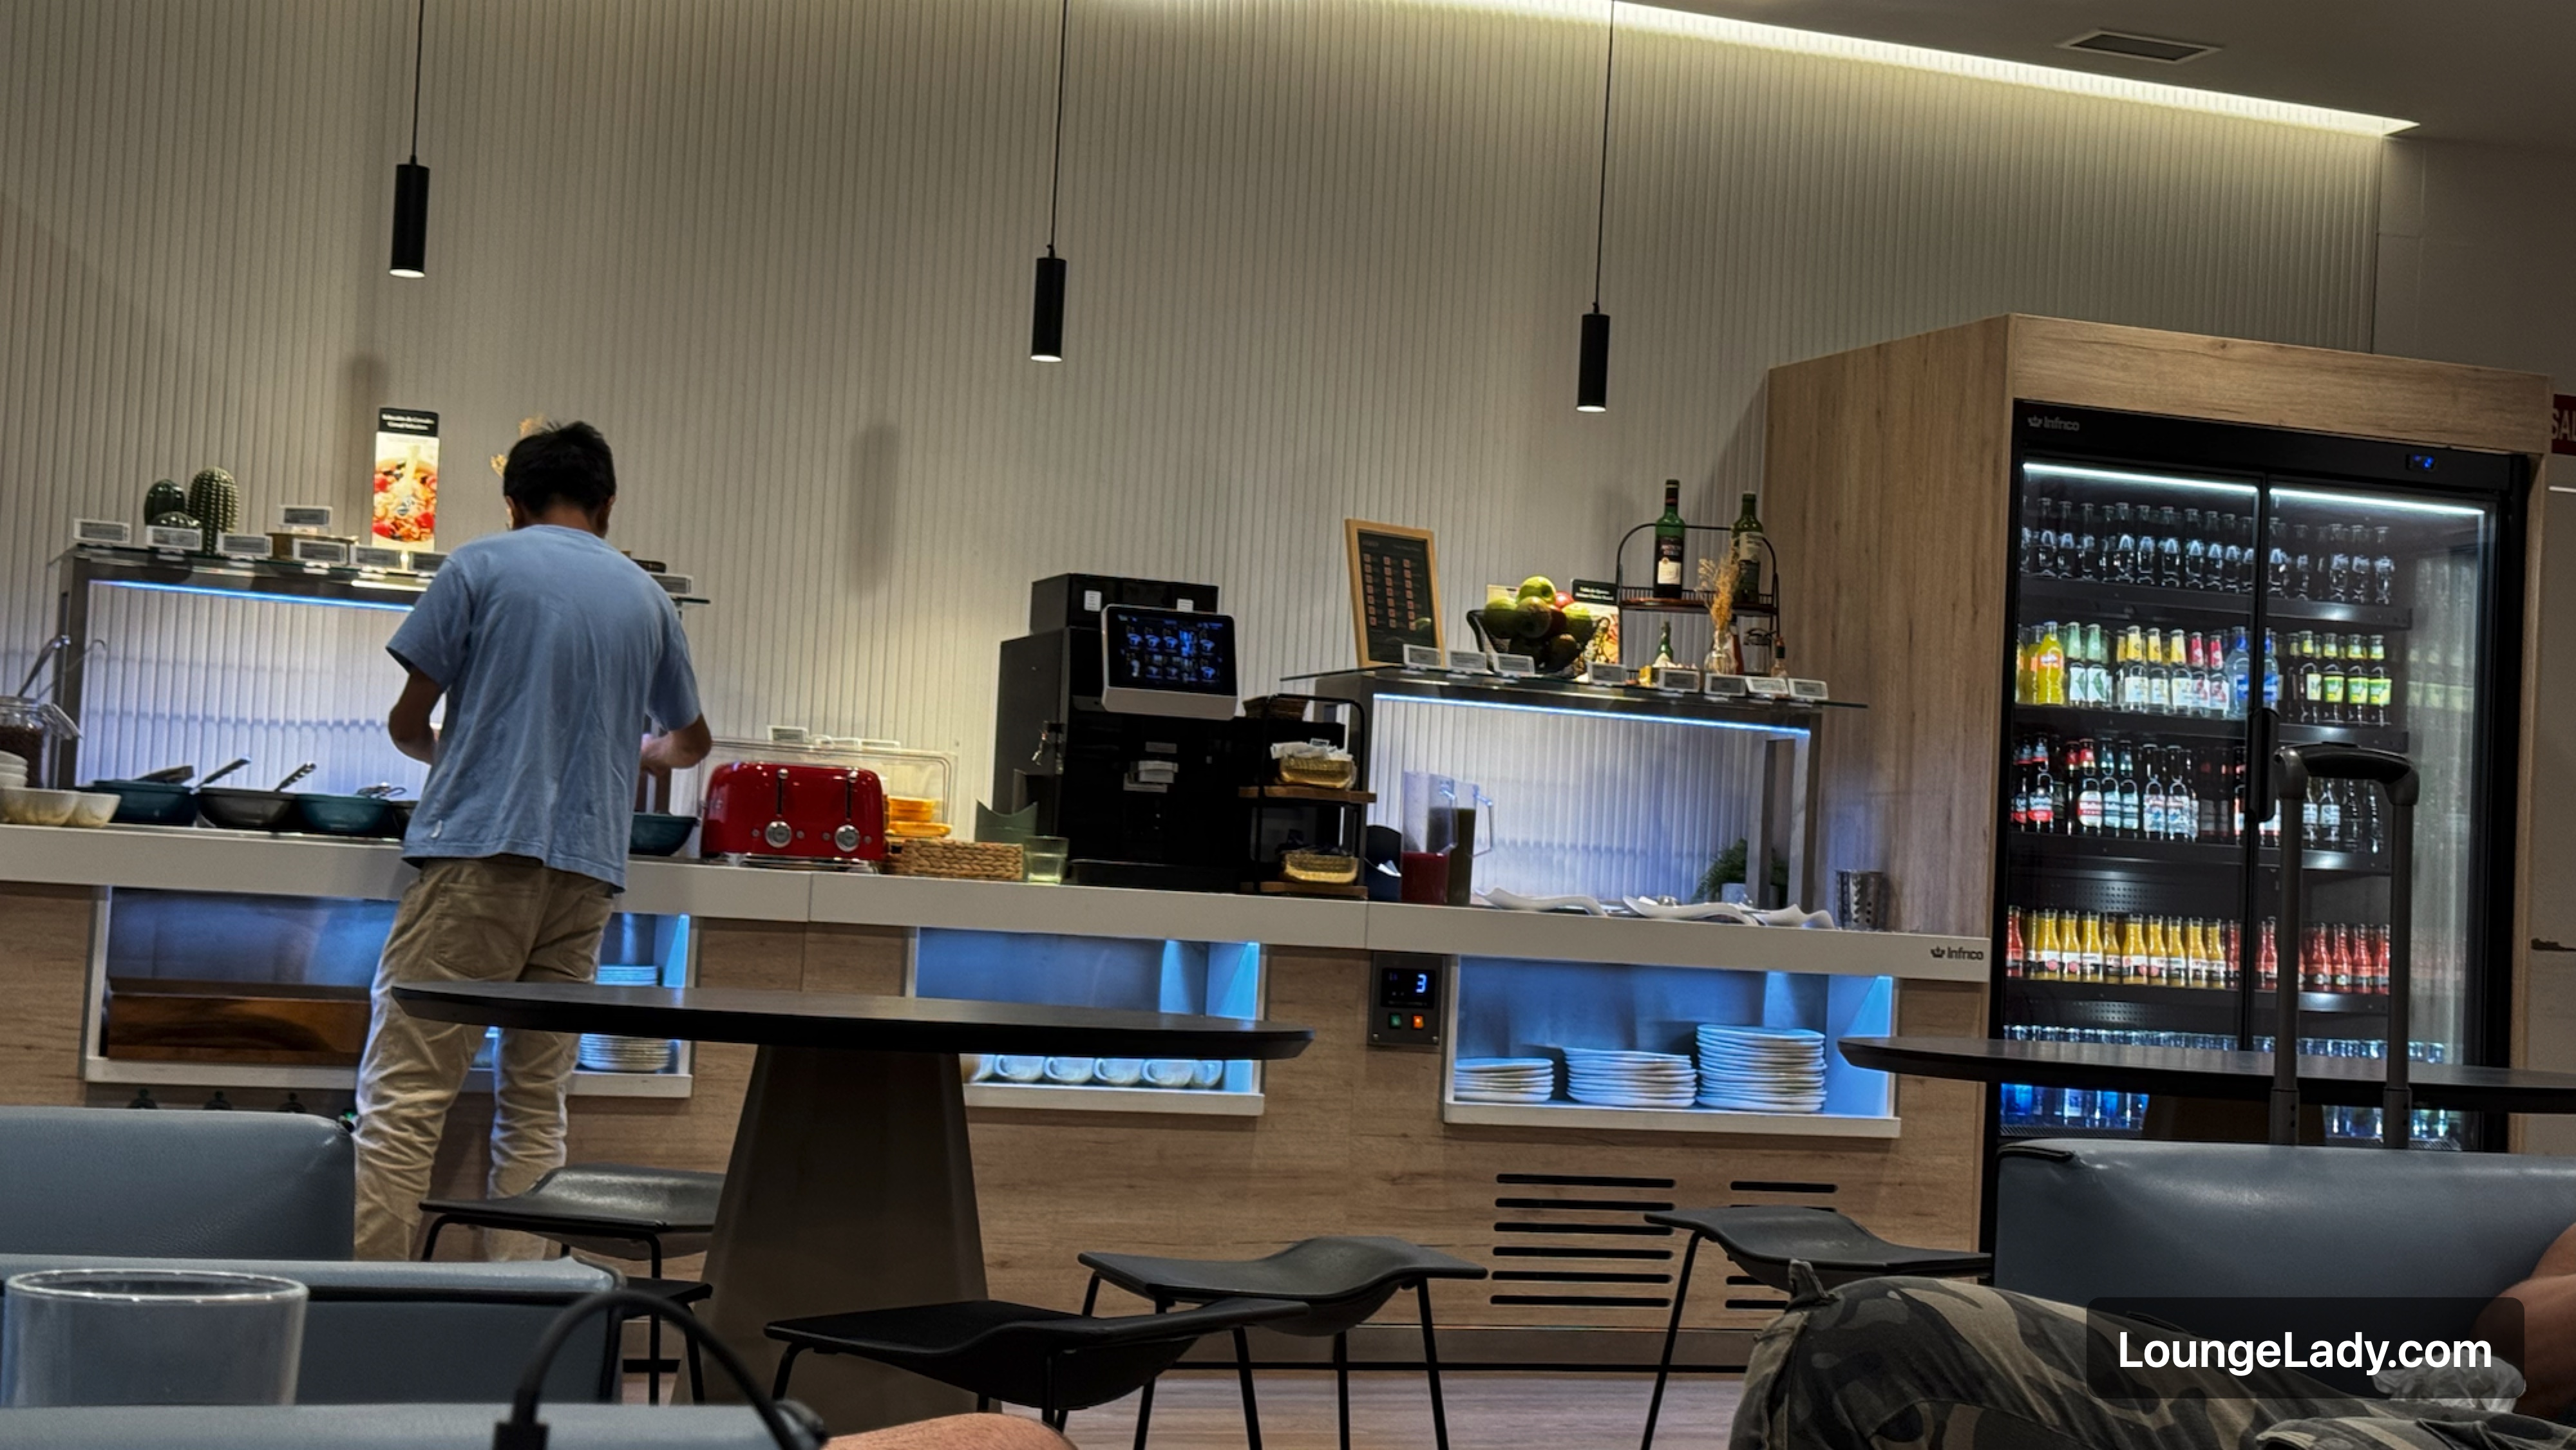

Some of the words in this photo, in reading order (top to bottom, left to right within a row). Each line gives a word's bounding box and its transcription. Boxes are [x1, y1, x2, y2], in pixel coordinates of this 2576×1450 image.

[2043, 415, 2079, 431] Infrico
[1947, 946, 1984, 961] Infrico
[1416, 973, 1427, 993] 3
